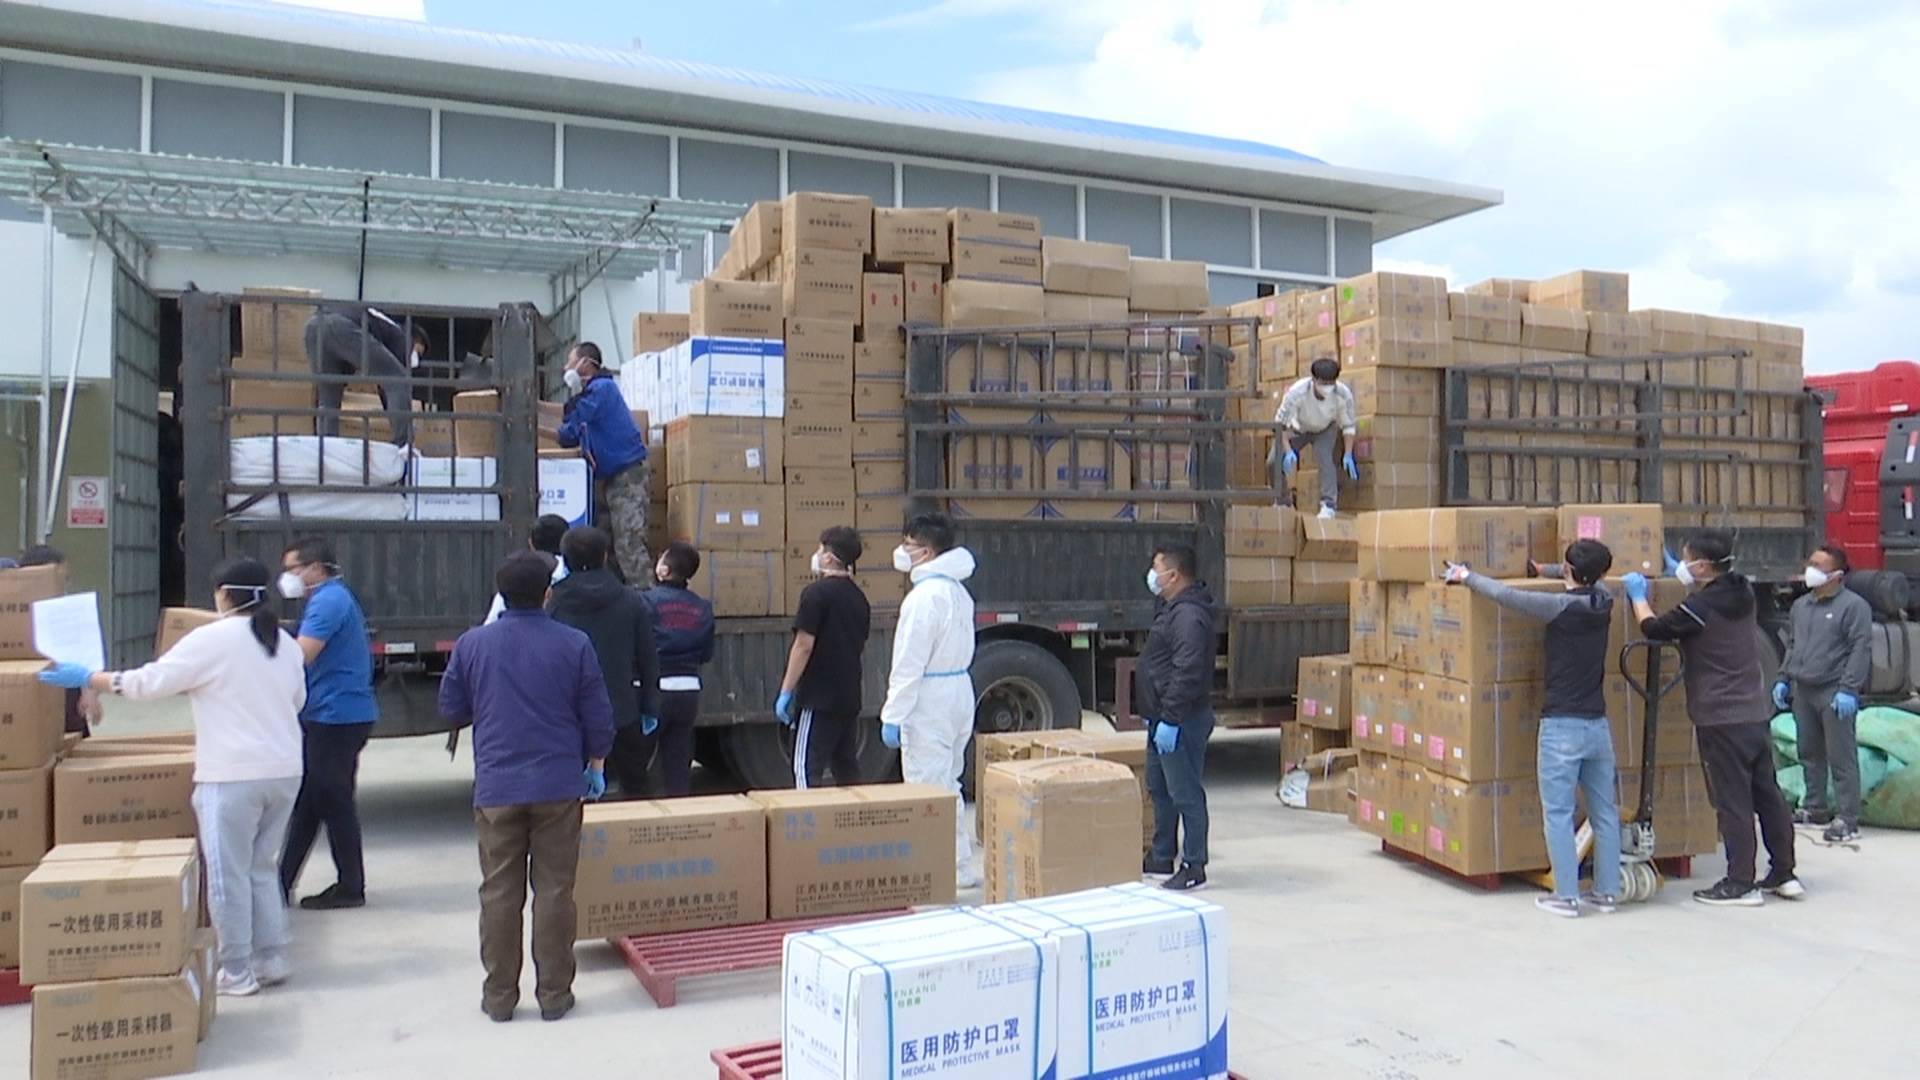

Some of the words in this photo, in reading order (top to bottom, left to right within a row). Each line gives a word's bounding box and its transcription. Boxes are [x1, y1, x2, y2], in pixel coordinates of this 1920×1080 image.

[49, 910, 163, 934] 一次性使用采样器
[1095, 980, 1195, 1019] 医用防护口罩
[56, 1013, 173, 1042] 一次性使用采样器
[1096, 1020, 1125, 1032] MEDICAL
[1130, 1010, 1170, 1025] PROTECTIVE
[1175, 1003, 1197, 1016] MASK
[901, 1017, 1020, 1065] 医用防护口罩
[901, 1063, 936, 1078] MEDICAL
[942, 1050, 990, 1070] PROTECTIVE
[995, 1043, 1021, 1057] MASK
